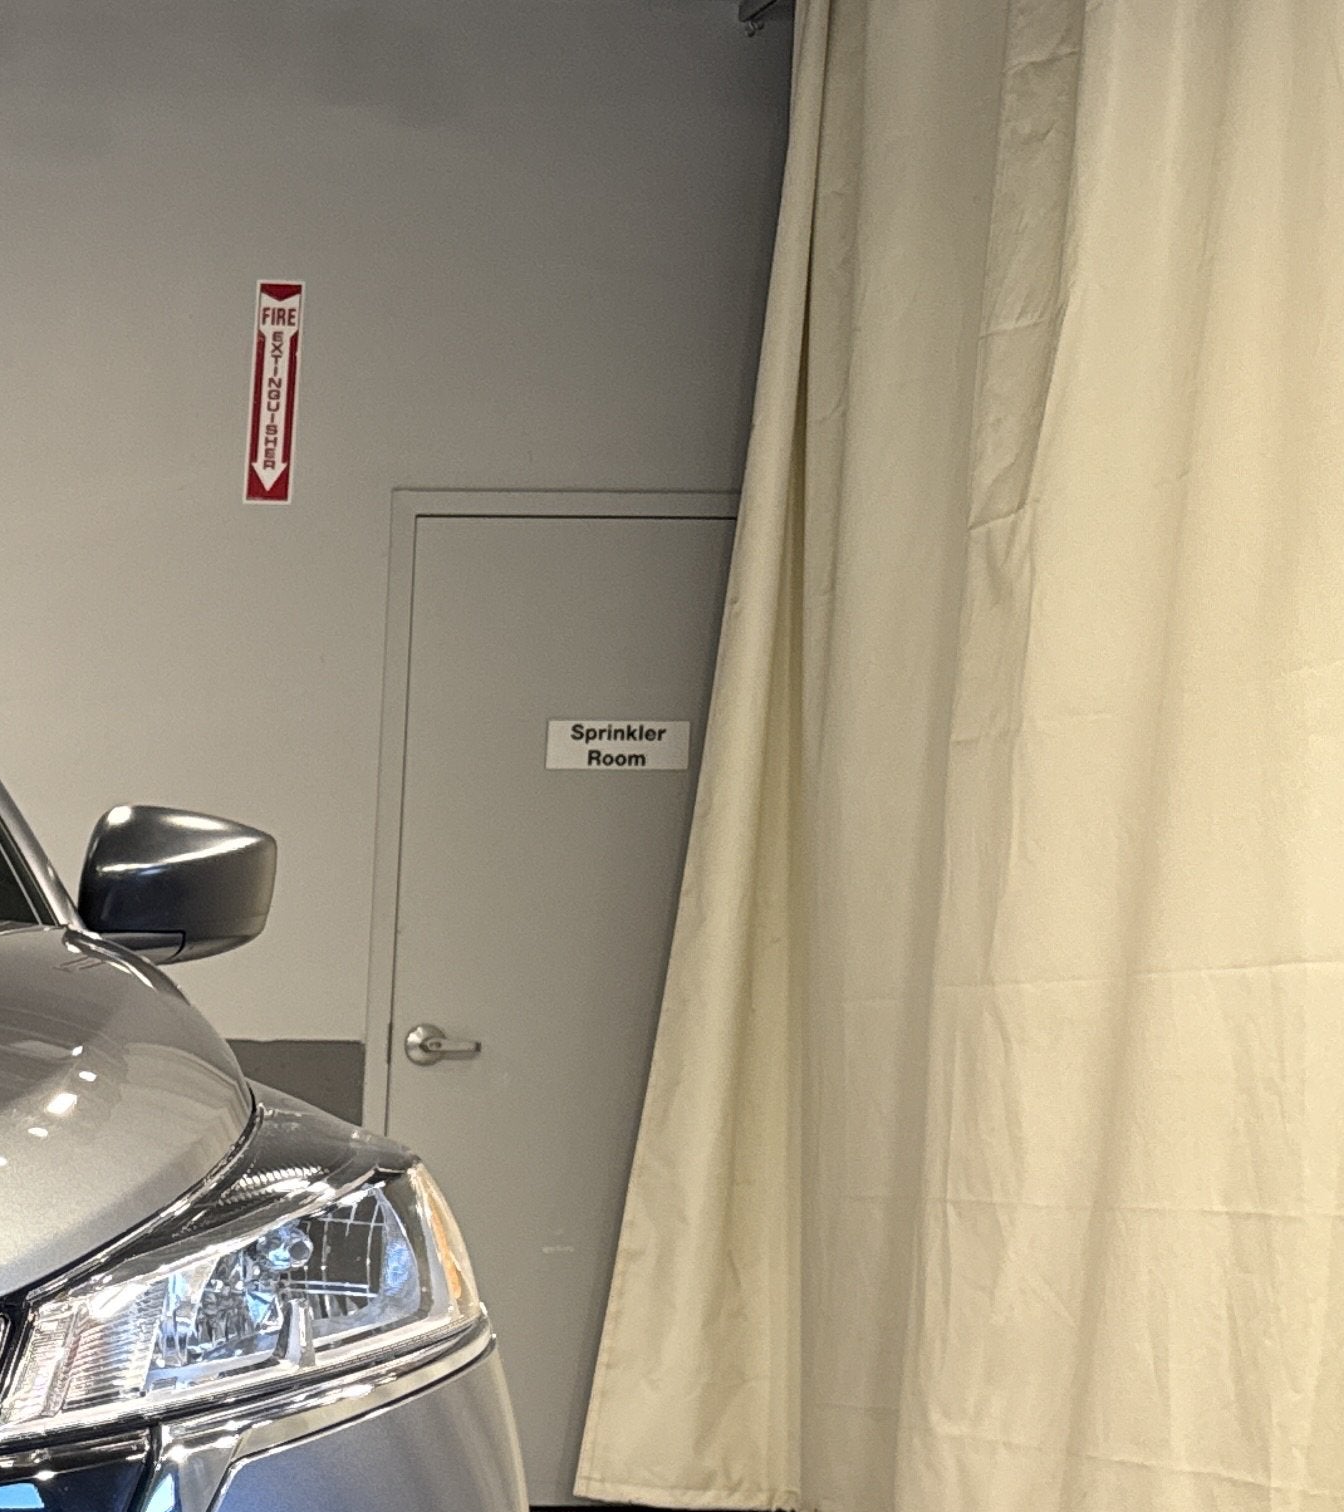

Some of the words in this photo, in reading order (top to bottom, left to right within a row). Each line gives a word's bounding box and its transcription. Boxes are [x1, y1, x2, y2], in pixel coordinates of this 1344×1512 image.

[262, 307, 296, 326] FIRE
[263, 331, 284, 470] EXTINGUISHER
[570, 723, 667, 744] Sprinkler
[587, 750, 647, 767] Room
